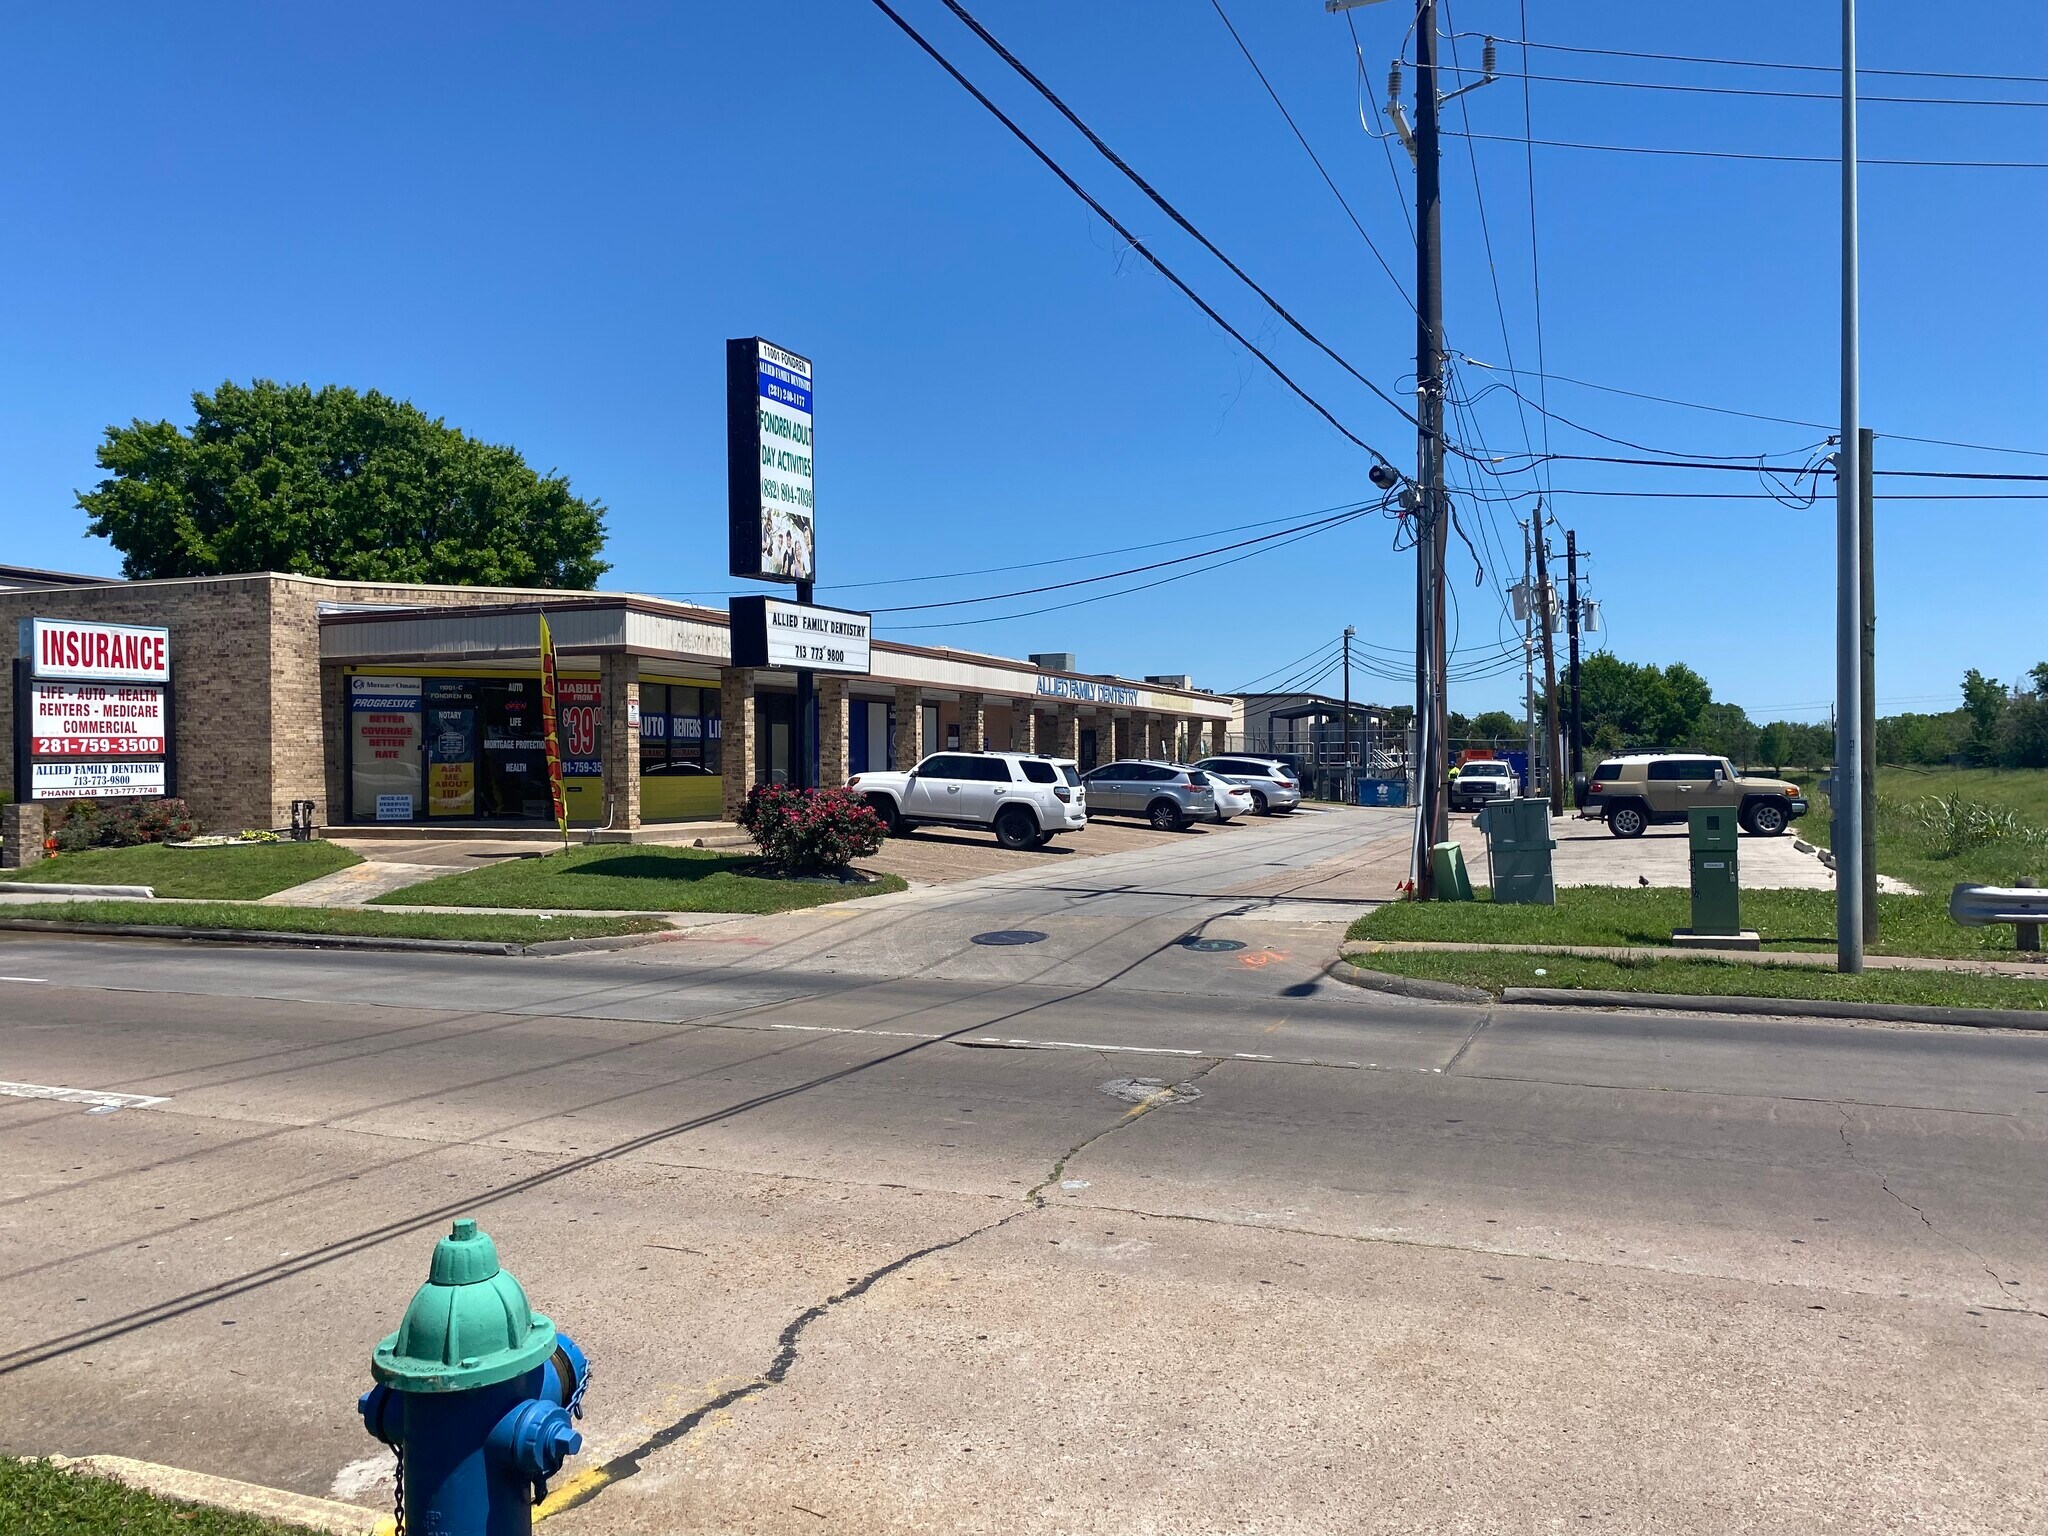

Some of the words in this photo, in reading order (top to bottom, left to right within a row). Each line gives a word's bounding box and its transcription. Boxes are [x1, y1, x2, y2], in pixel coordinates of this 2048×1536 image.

[764, 345, 780, 362] 11001
[781, 352, 806, 374] FONDREN
[760, 361, 775, 378] ALLIED
[776, 368, 790, 384] FAMILY
[790, 374, 810, 392] DENTISTRY
[760, 410, 792, 440] FONDREN
[792, 422, 812, 446] ADULT
[762, 444, 776, 468] DAY
[778, 450, 811, 478] ACTIVITIES
[762, 478, 780, 501] (832)
[780, 483, 812, 508] 804-7039
[772, 612, 798, 628] ALLIED
[802, 616, 828, 632] FAMILY
[830, 621, 866, 638] DENTISTRY
[42, 630, 164, 670] INSURANCE
[795, 645, 806, 658] 713
[811, 646, 824, 660] 773
[828, 648, 844, 662] 9800
[40, 686, 64, 699] LIFE
[77, 687, 106, 700] AUTO
[118, 688, 157, 702] HEALTH
[508, 683, 523, 692] AUTO
[1036, 676, 1068, 697] ALLIED
[1069, 680, 1096, 701] FAMILY
[1098, 683, 1138, 706] DENTISTRY
[40, 702, 90, 716] RENTERS
[103, 704, 158, 718] MEDICARE
[353, 698, 416, 708] PROGRESSIVE
[370, 714, 405, 724] BETTER
[438, 711, 462, 720] NOTARY
[510, 718, 522, 726] LIFE
[63, 720, 138, 734] COMMERCIAL
[362, 726, 412, 736] COVERAGE
[640, 716, 664, 736] AUTO
[674, 718, 702, 738] RENTERS
[38, 738, 158, 752] 281-759-3500
[369, 738, 404, 747] BETTER
[484, 740, 514, 748] MORTGAGE
[375, 750, 399, 758] RATE
[36, 766, 72, 776] ALLIED
[76, 764, 108, 774] FAMILY
[112, 764, 160, 774] DENTISTRY
[441, 764, 462, 772] ASK
[506, 763, 526, 772] HEALTH
[73, 776, 130, 786] 713-773-9800
